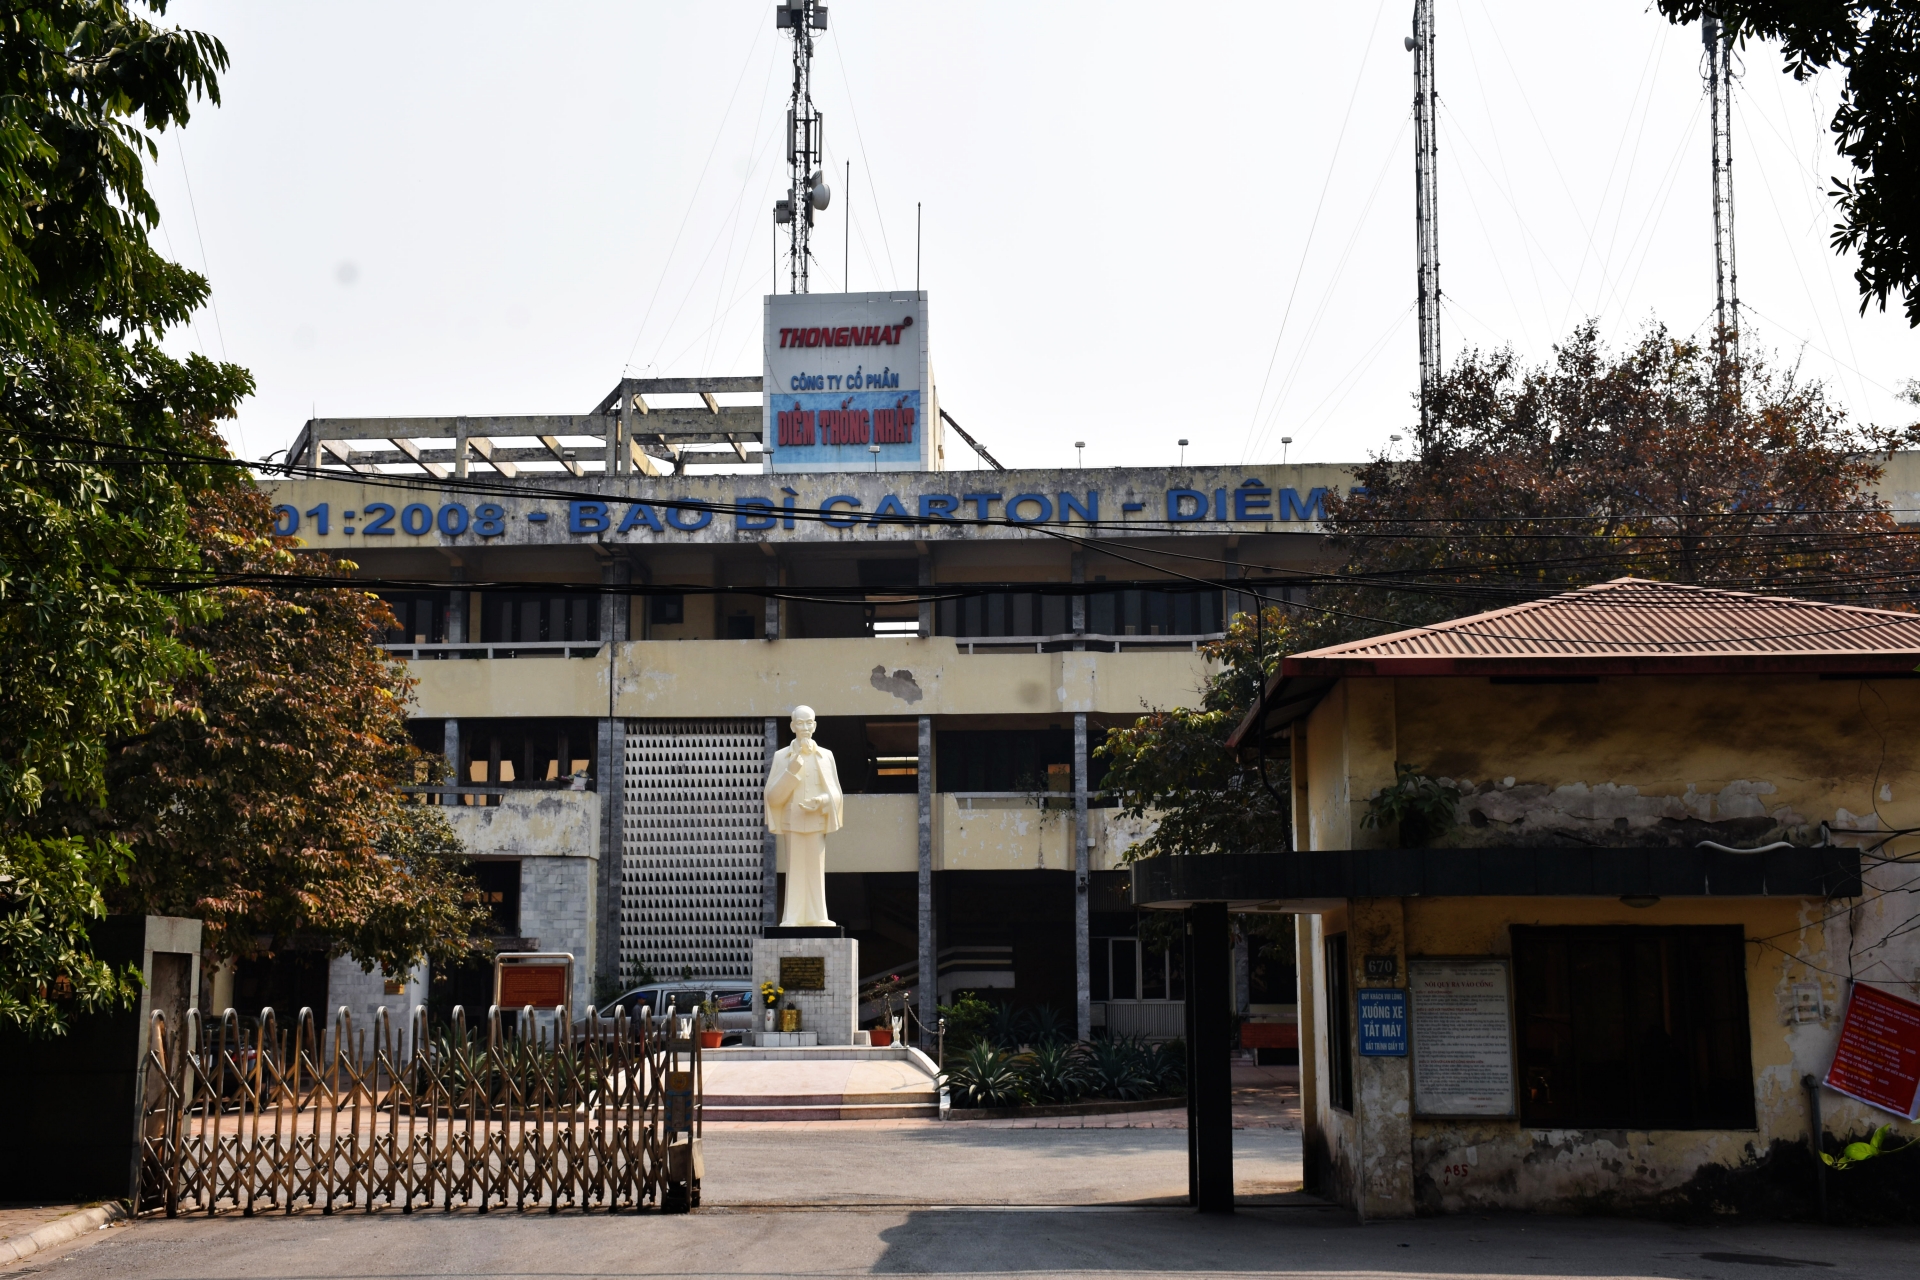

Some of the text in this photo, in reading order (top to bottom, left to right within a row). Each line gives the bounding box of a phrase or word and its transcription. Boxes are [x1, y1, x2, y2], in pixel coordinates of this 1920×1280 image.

[780, 325, 905, 348] THONGNHAT
[791, 365, 899, 391] CÔNG TY CỔ PHẦN
[777, 395, 915, 446] DIÊM THỐNG NHẤT
[569, 497, 713, 533] BAO
[735, 487, 799, 531] BÌ
[819, 491, 1099, 528] CARTON
[1166, 478, 1328, 522] DIÊM
[1368, 960, 1393, 972] 670
[1362, 1002, 1404, 1019] XUỐNG XE
[1382, 1021, 1402, 1037] MÁY
[1444, 1164, 1468, 1177] A85
